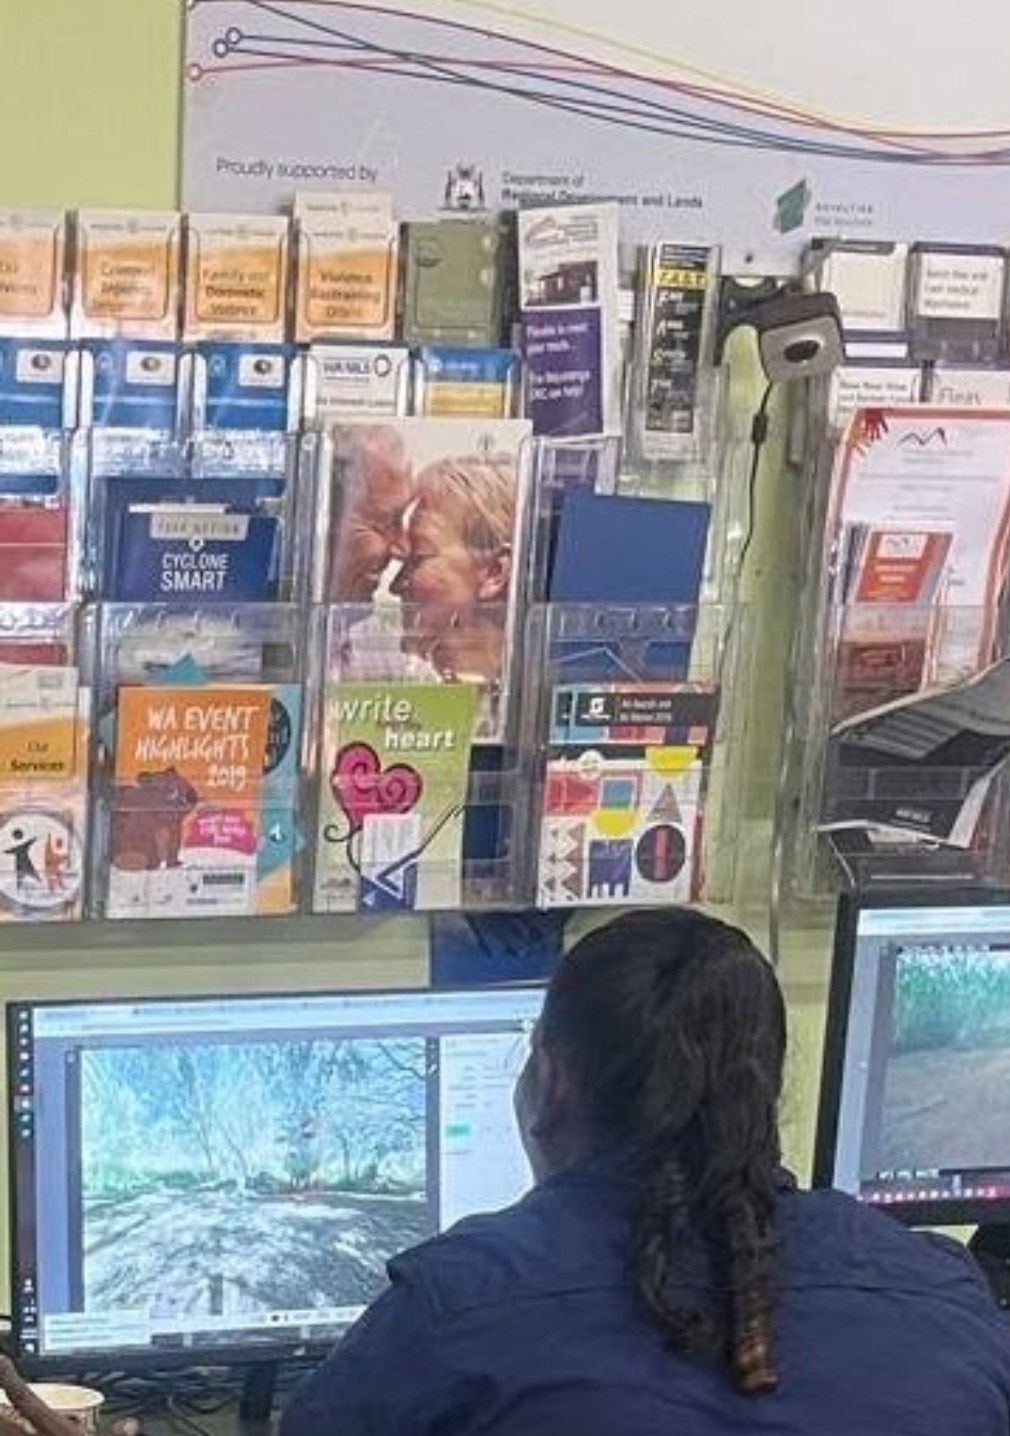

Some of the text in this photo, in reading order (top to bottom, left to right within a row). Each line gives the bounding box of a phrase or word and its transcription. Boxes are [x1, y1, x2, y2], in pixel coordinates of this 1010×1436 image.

[216, 156, 378, 184] Proudly supported by
[162, 552, 230, 570] CYCLONE
[160, 570, 226, 593] SMART
[148, 704, 259, 732] WA EVENT
[329, 693, 412, 722] write
[134, 733, 250, 762] HIGHLIGHTS
[385, 726, 455, 749] heart
